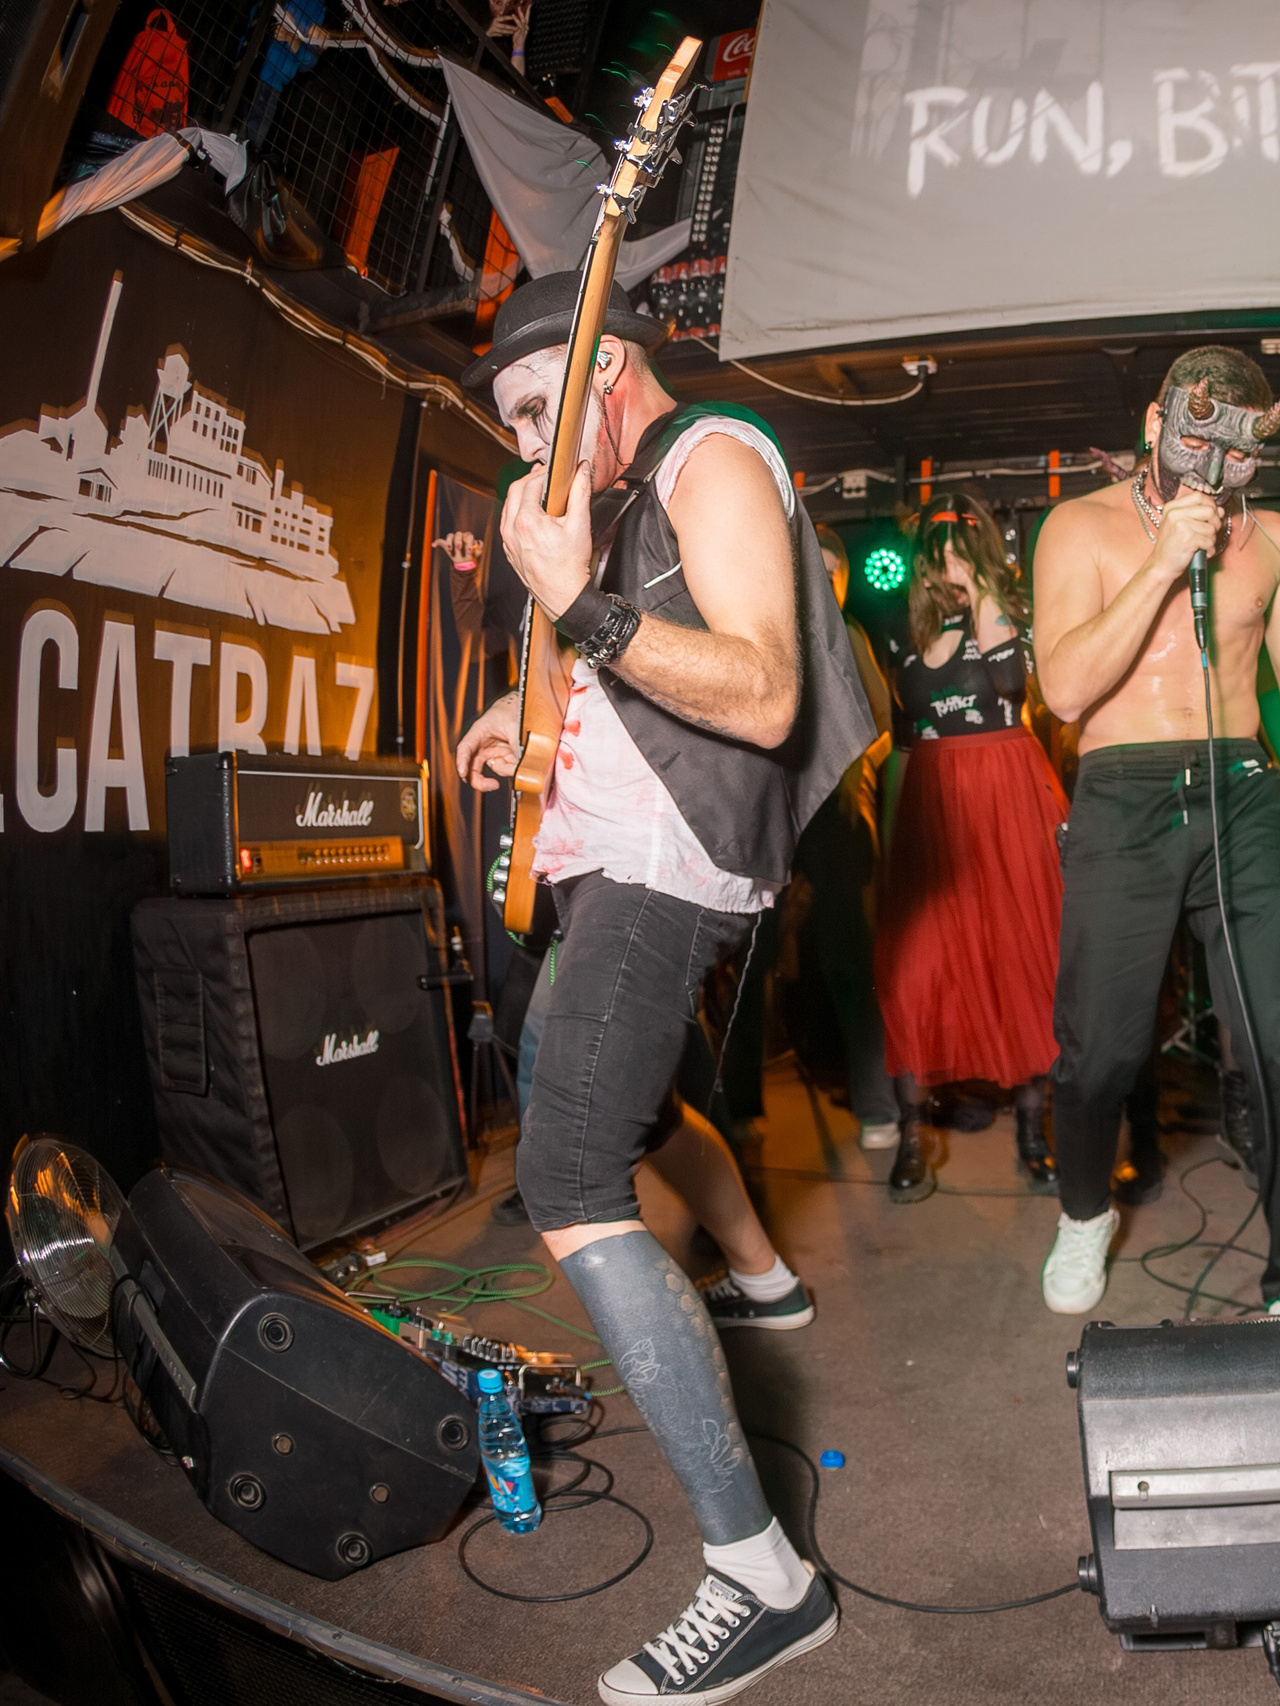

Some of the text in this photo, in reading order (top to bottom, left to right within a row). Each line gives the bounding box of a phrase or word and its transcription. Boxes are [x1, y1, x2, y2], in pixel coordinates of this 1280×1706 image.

[904, 84, 1133, 197] RUN,
[296, 792, 374, 827] Marshall
[316, 1029, 379, 1066] Marshall
